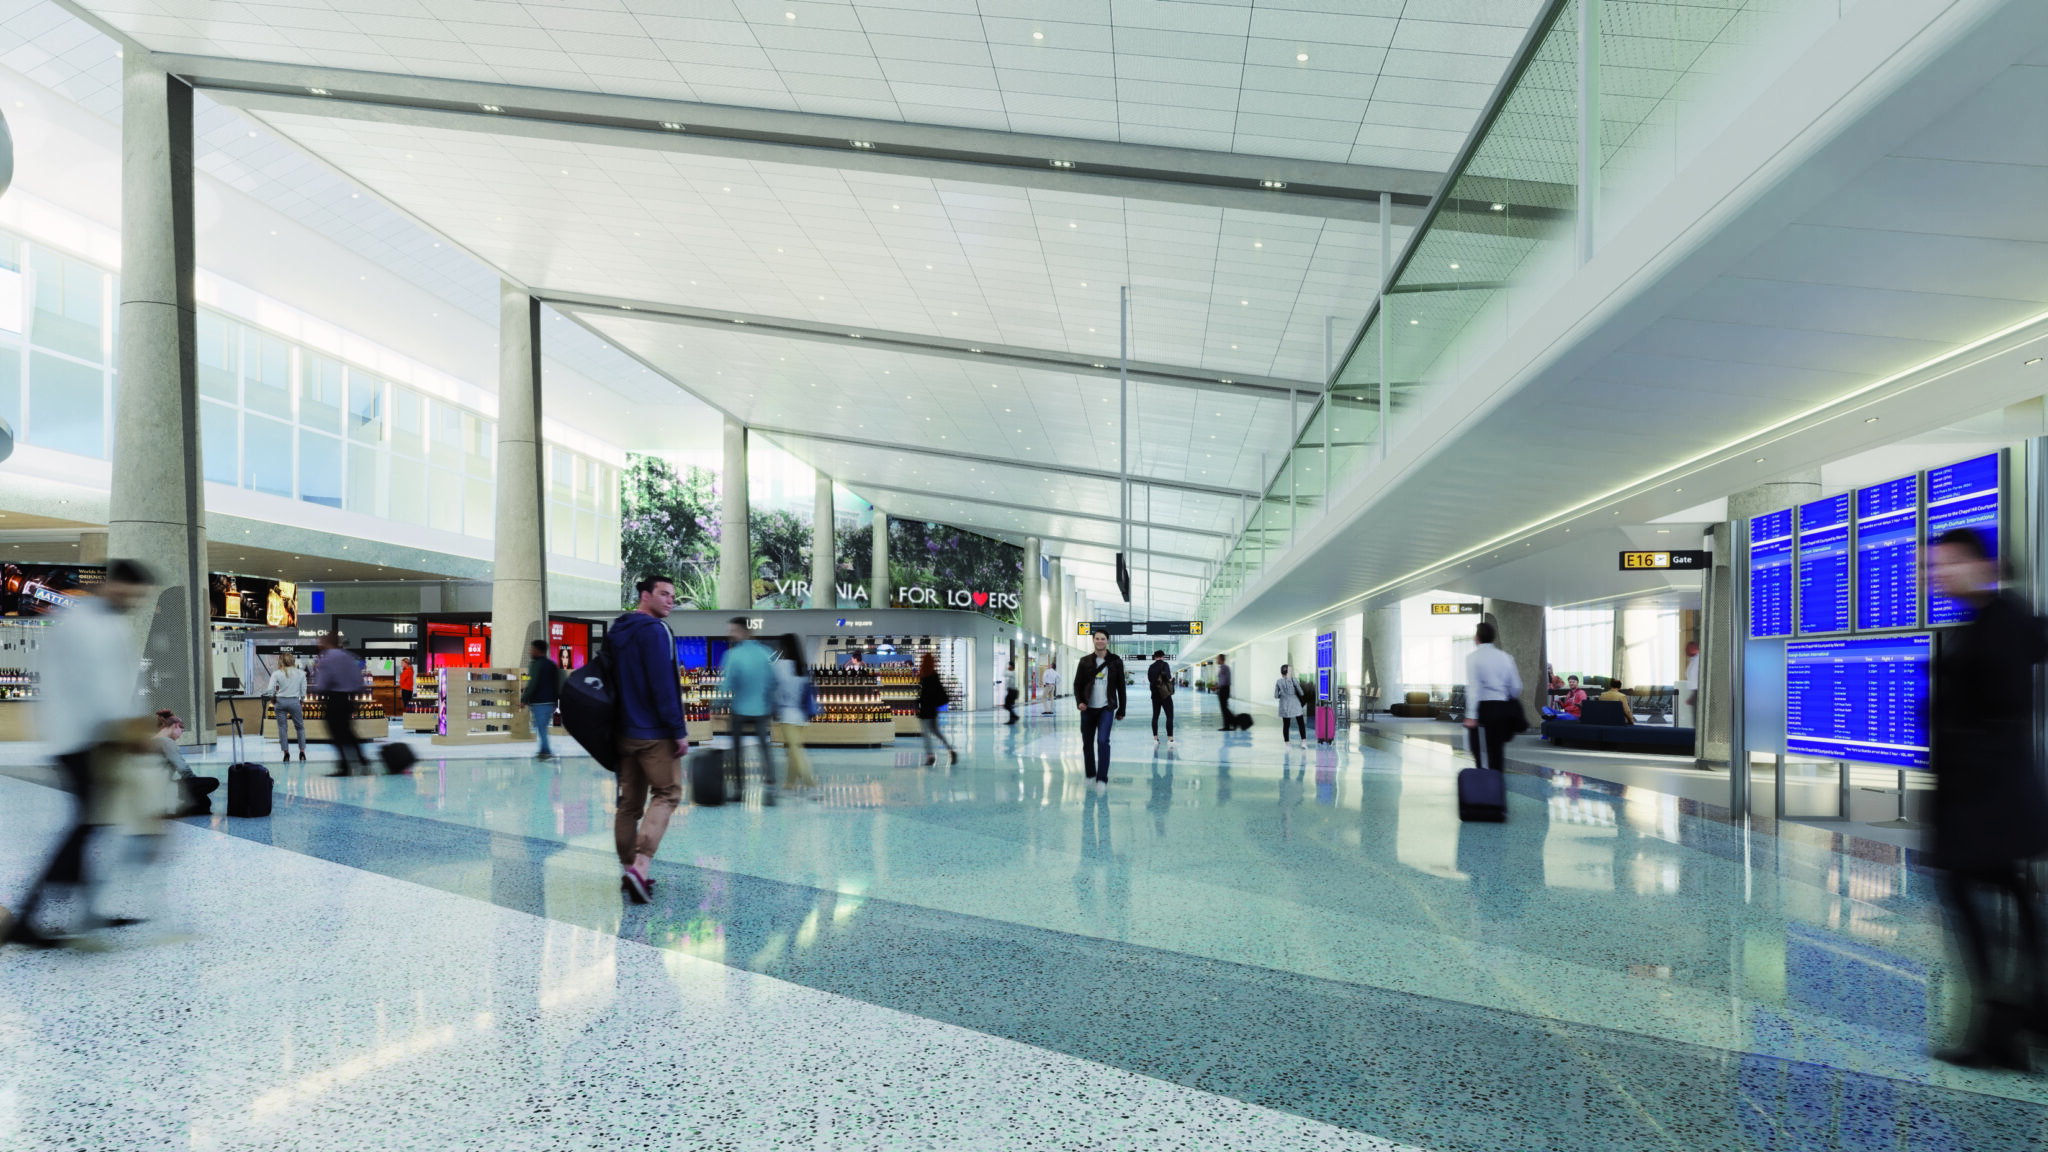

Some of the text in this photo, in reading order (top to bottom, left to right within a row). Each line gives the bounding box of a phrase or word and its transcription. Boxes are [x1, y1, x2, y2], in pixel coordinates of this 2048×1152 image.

[1627, 554, 1653, 566] E16
[774, 579, 869, 600] VIRNIA
[899, 587, 939, 604] FOR
[746, 619, 764, 629] UST
